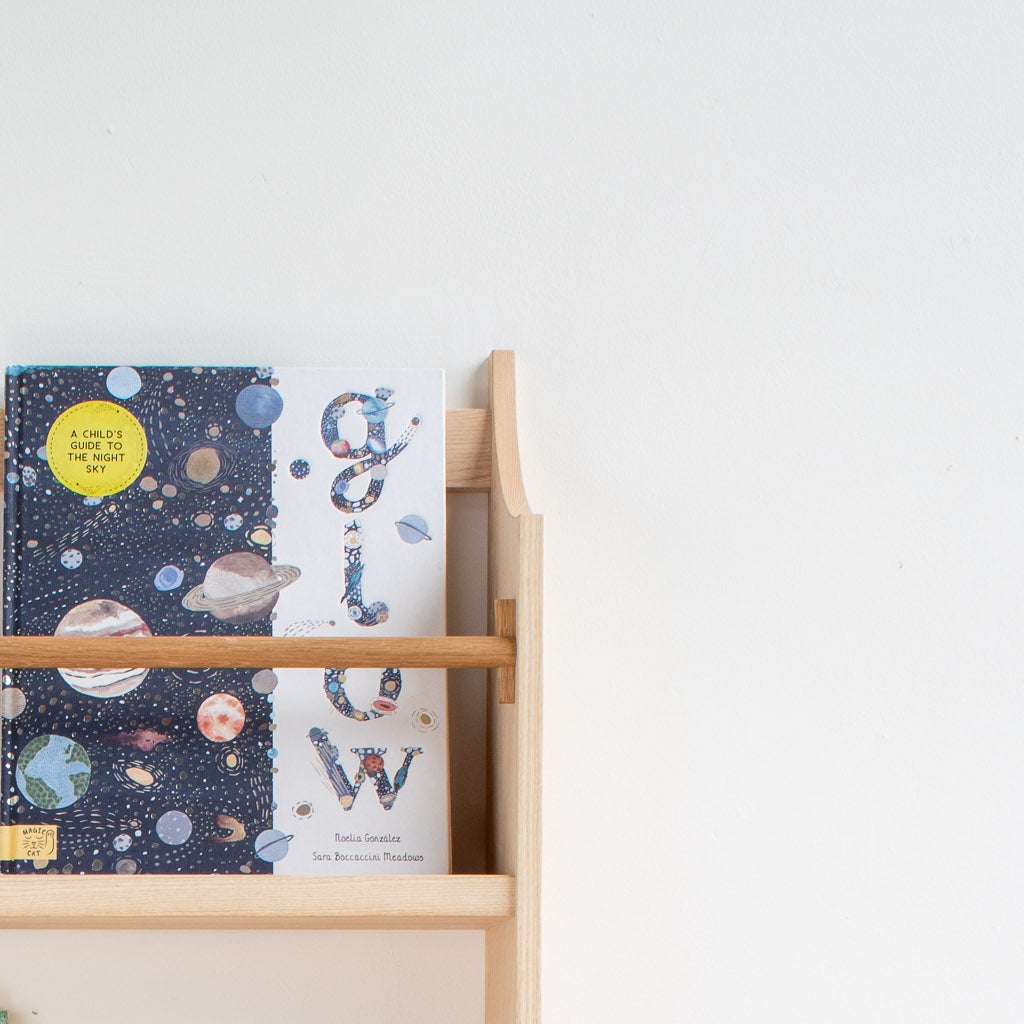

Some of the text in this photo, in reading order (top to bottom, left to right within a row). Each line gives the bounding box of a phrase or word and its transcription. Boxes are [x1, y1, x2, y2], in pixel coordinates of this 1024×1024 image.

[70, 429, 123, 439] A CHILD'S
[70, 441, 123, 450] GUIDE TO
[67, 453, 126, 462] THE NIGHT
[86, 465, 106, 473] SKY
[22, 827, 46, 835] MAGIC
[335, 833, 362, 843] Noelia
[312, 851, 424, 862] Sara Boccaccini Meadows
